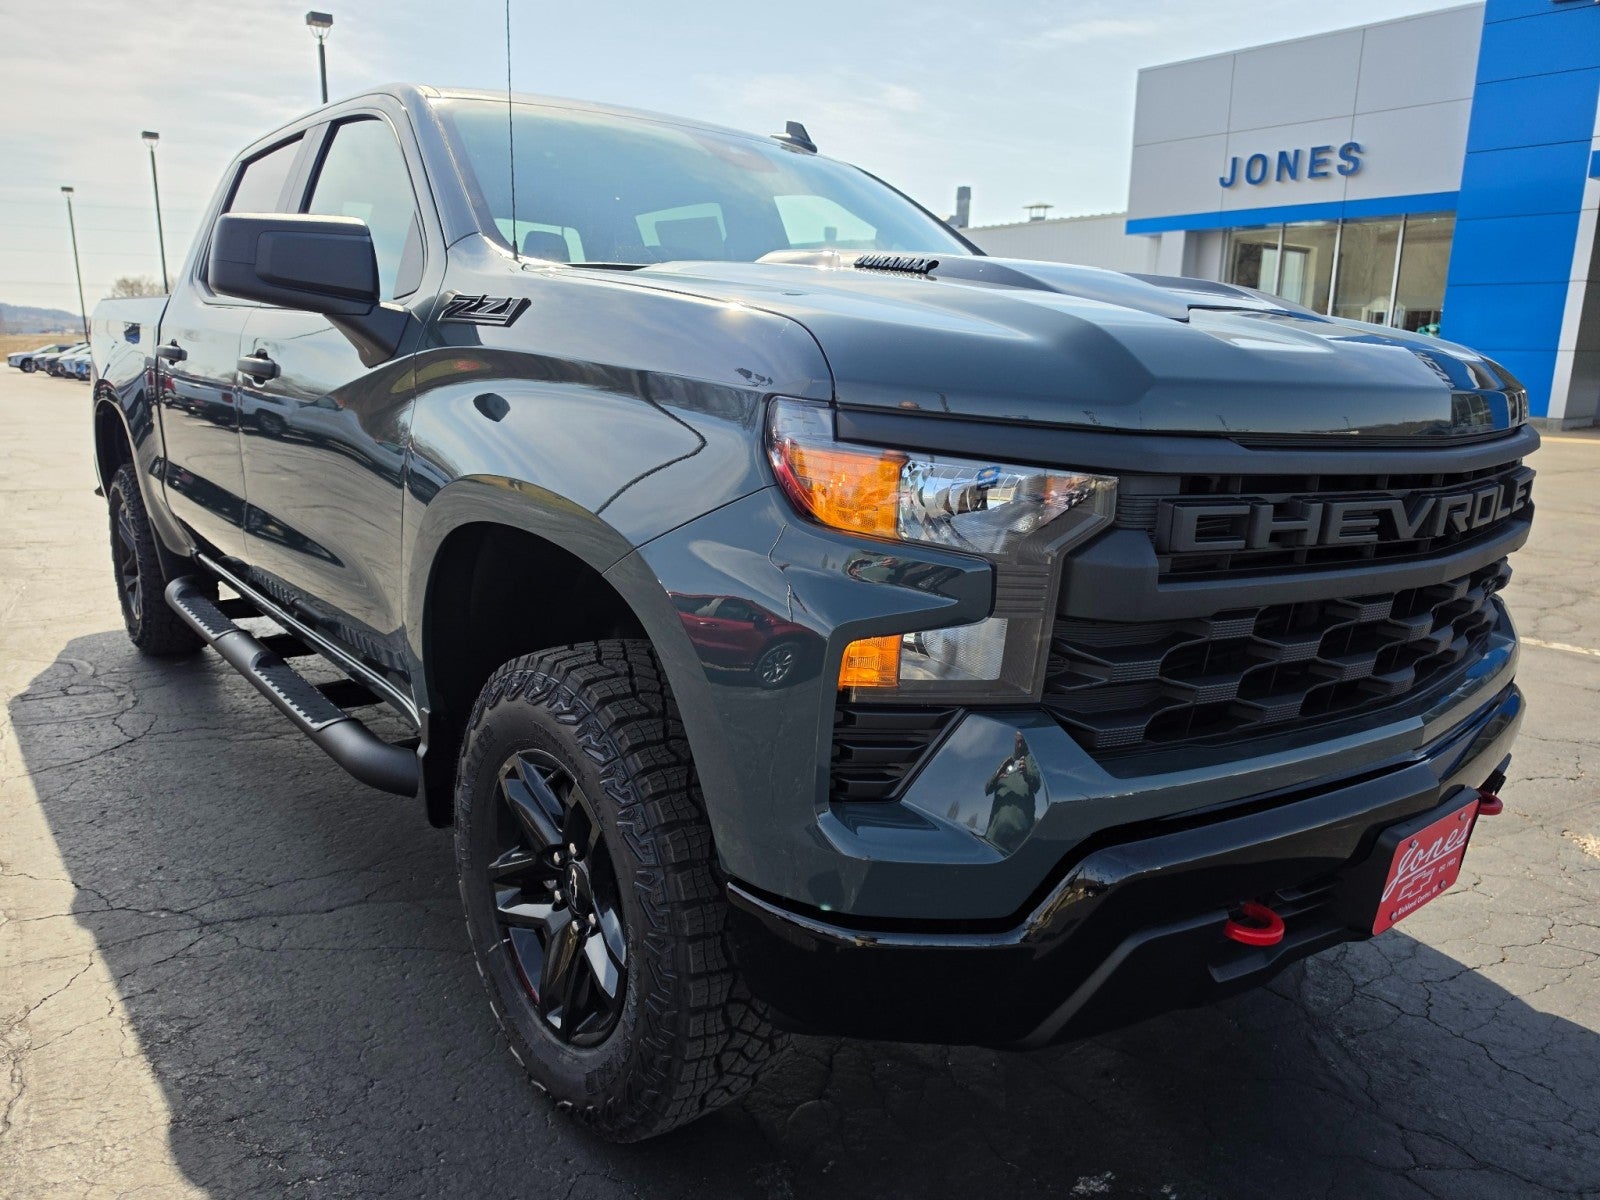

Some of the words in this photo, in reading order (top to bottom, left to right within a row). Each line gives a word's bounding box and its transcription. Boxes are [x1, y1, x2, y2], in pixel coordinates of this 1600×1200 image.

[1219, 142, 1365, 188] JONES
[854, 255, 937, 273] DURAMAX
[437, 294, 531, 328] Z71
[1166, 467, 1536, 551] CHEVROLE
[1381, 818, 1471, 902] Jones
